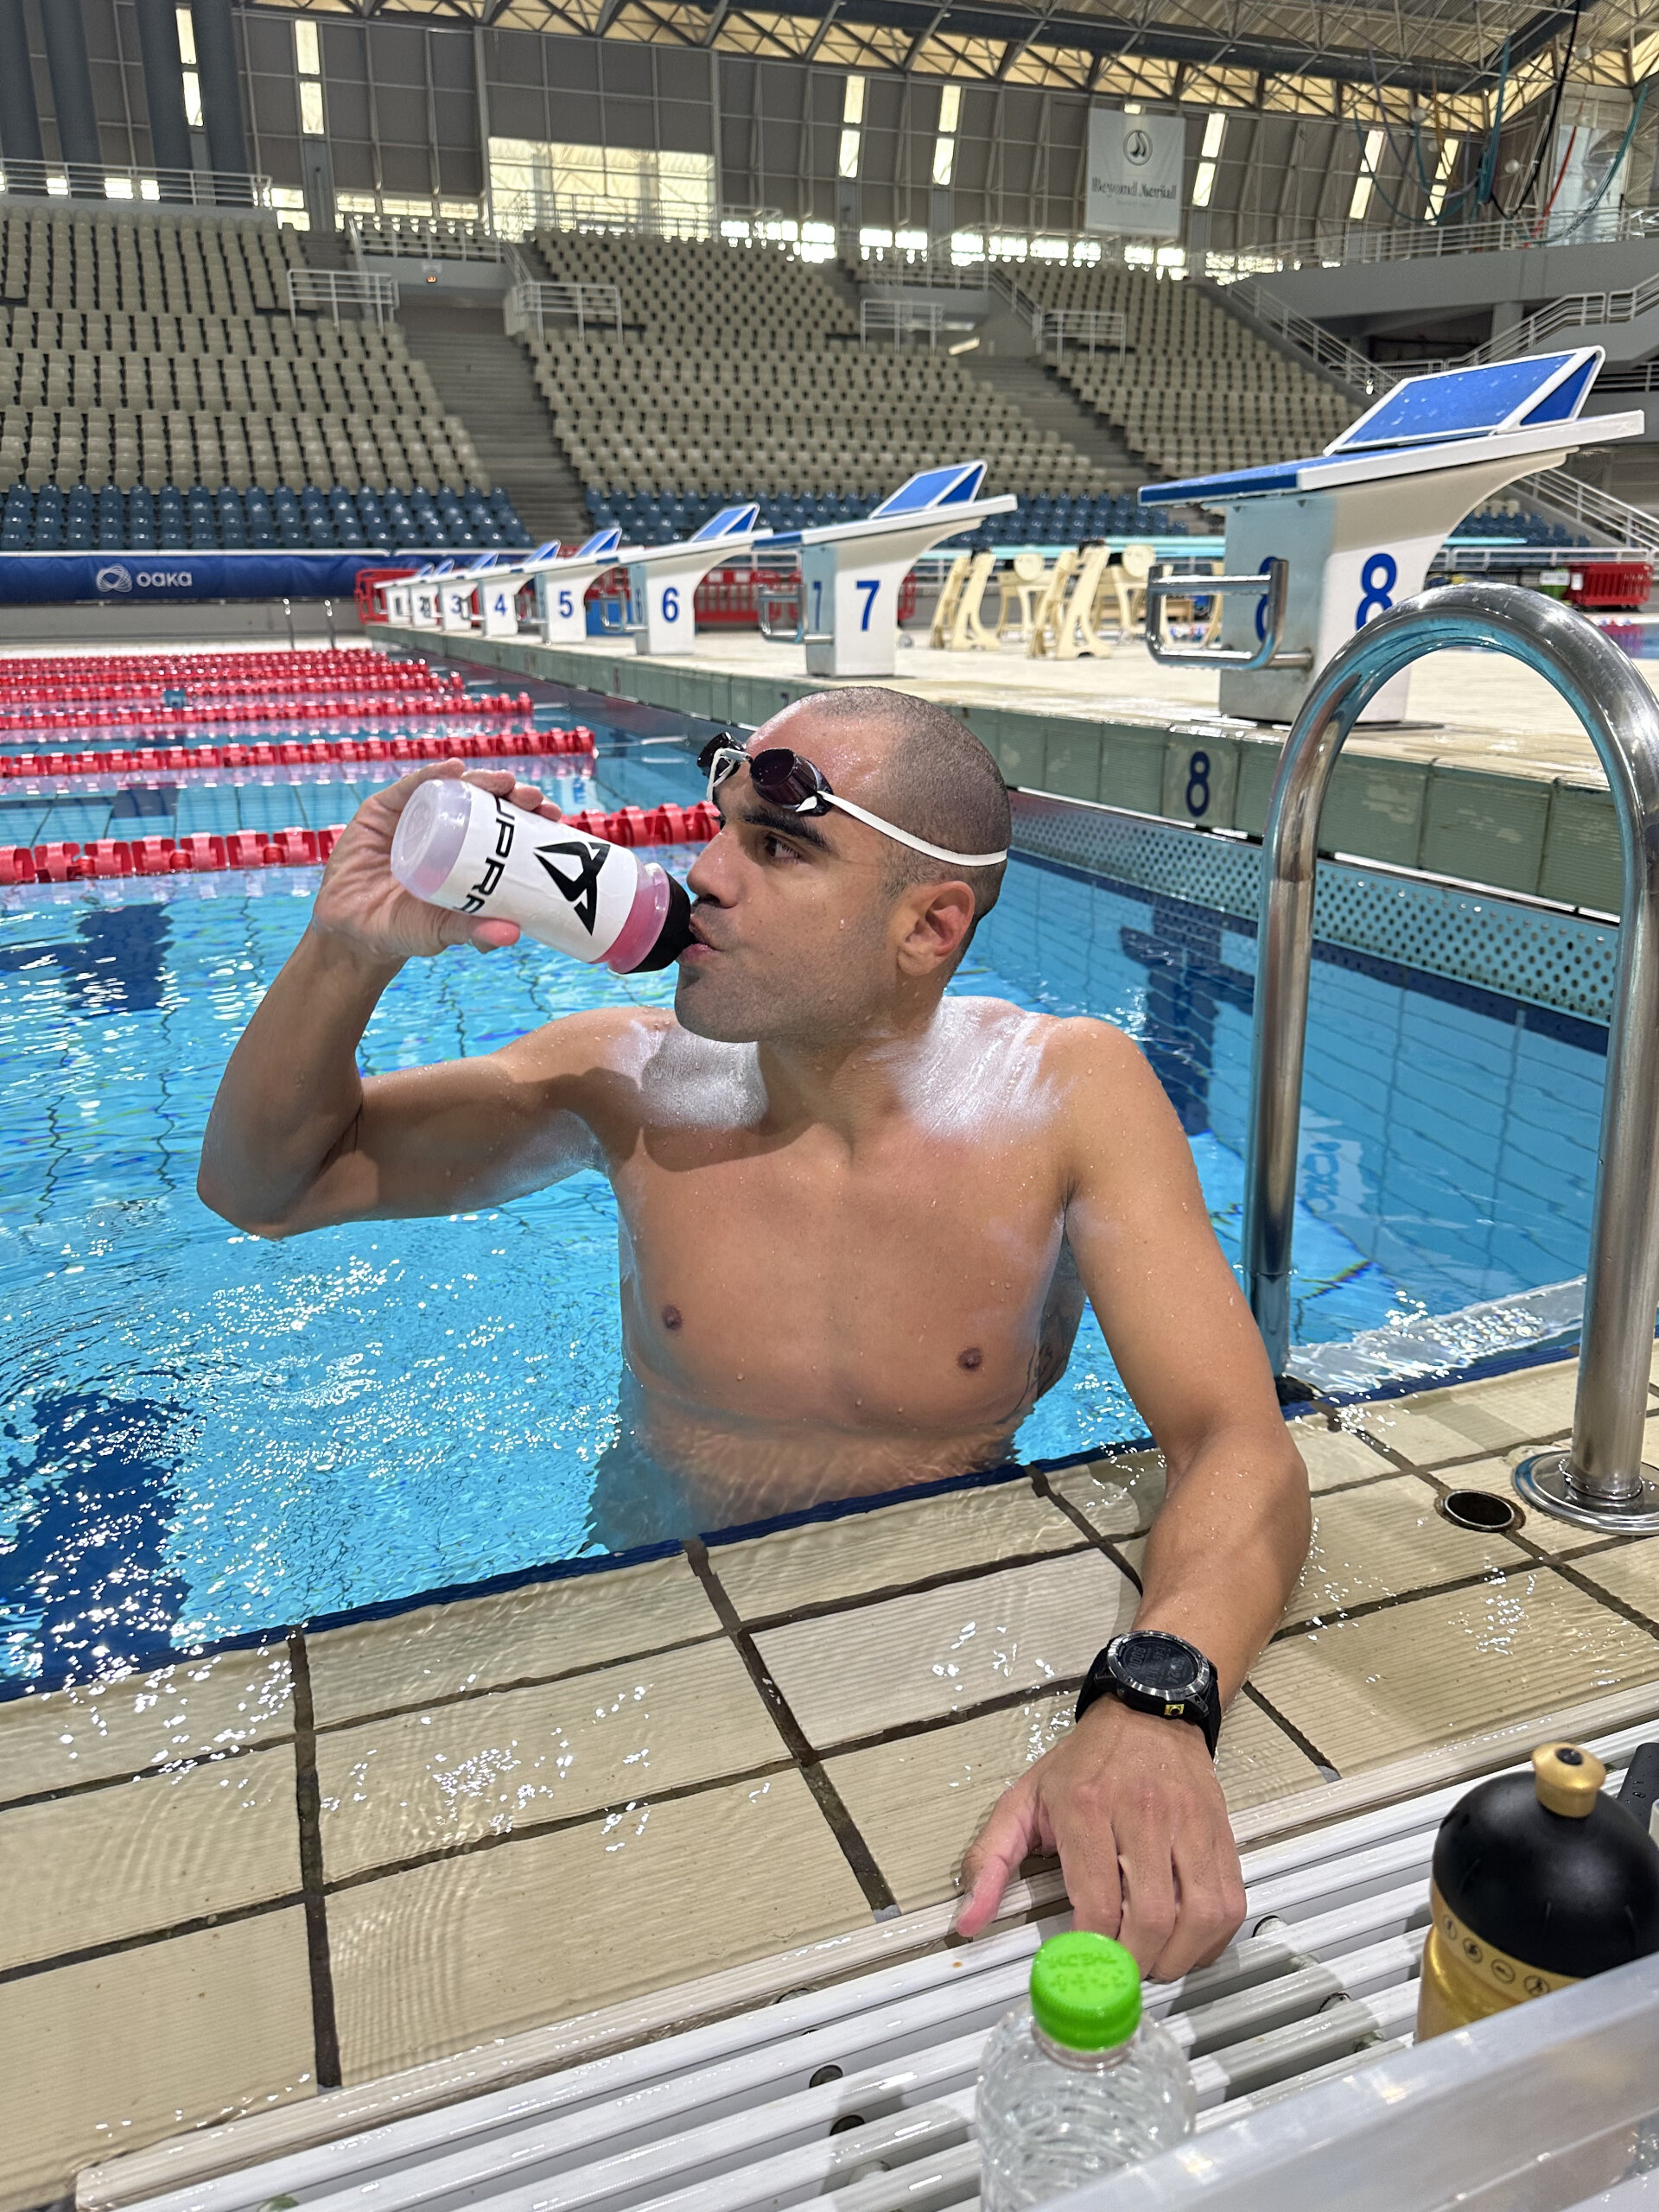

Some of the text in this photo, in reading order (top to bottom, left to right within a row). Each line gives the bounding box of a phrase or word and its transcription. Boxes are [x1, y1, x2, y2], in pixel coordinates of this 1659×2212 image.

[1092, 177, 1177, 200] Beyond Aerial
[450, 594, 461, 614] 3
[494, 594, 507, 615] 4
[559, 590, 574, 618] 5
[662, 587, 680, 624] 6
[856, 580, 880, 632] 7
[1186, 751, 1211, 817] 8
